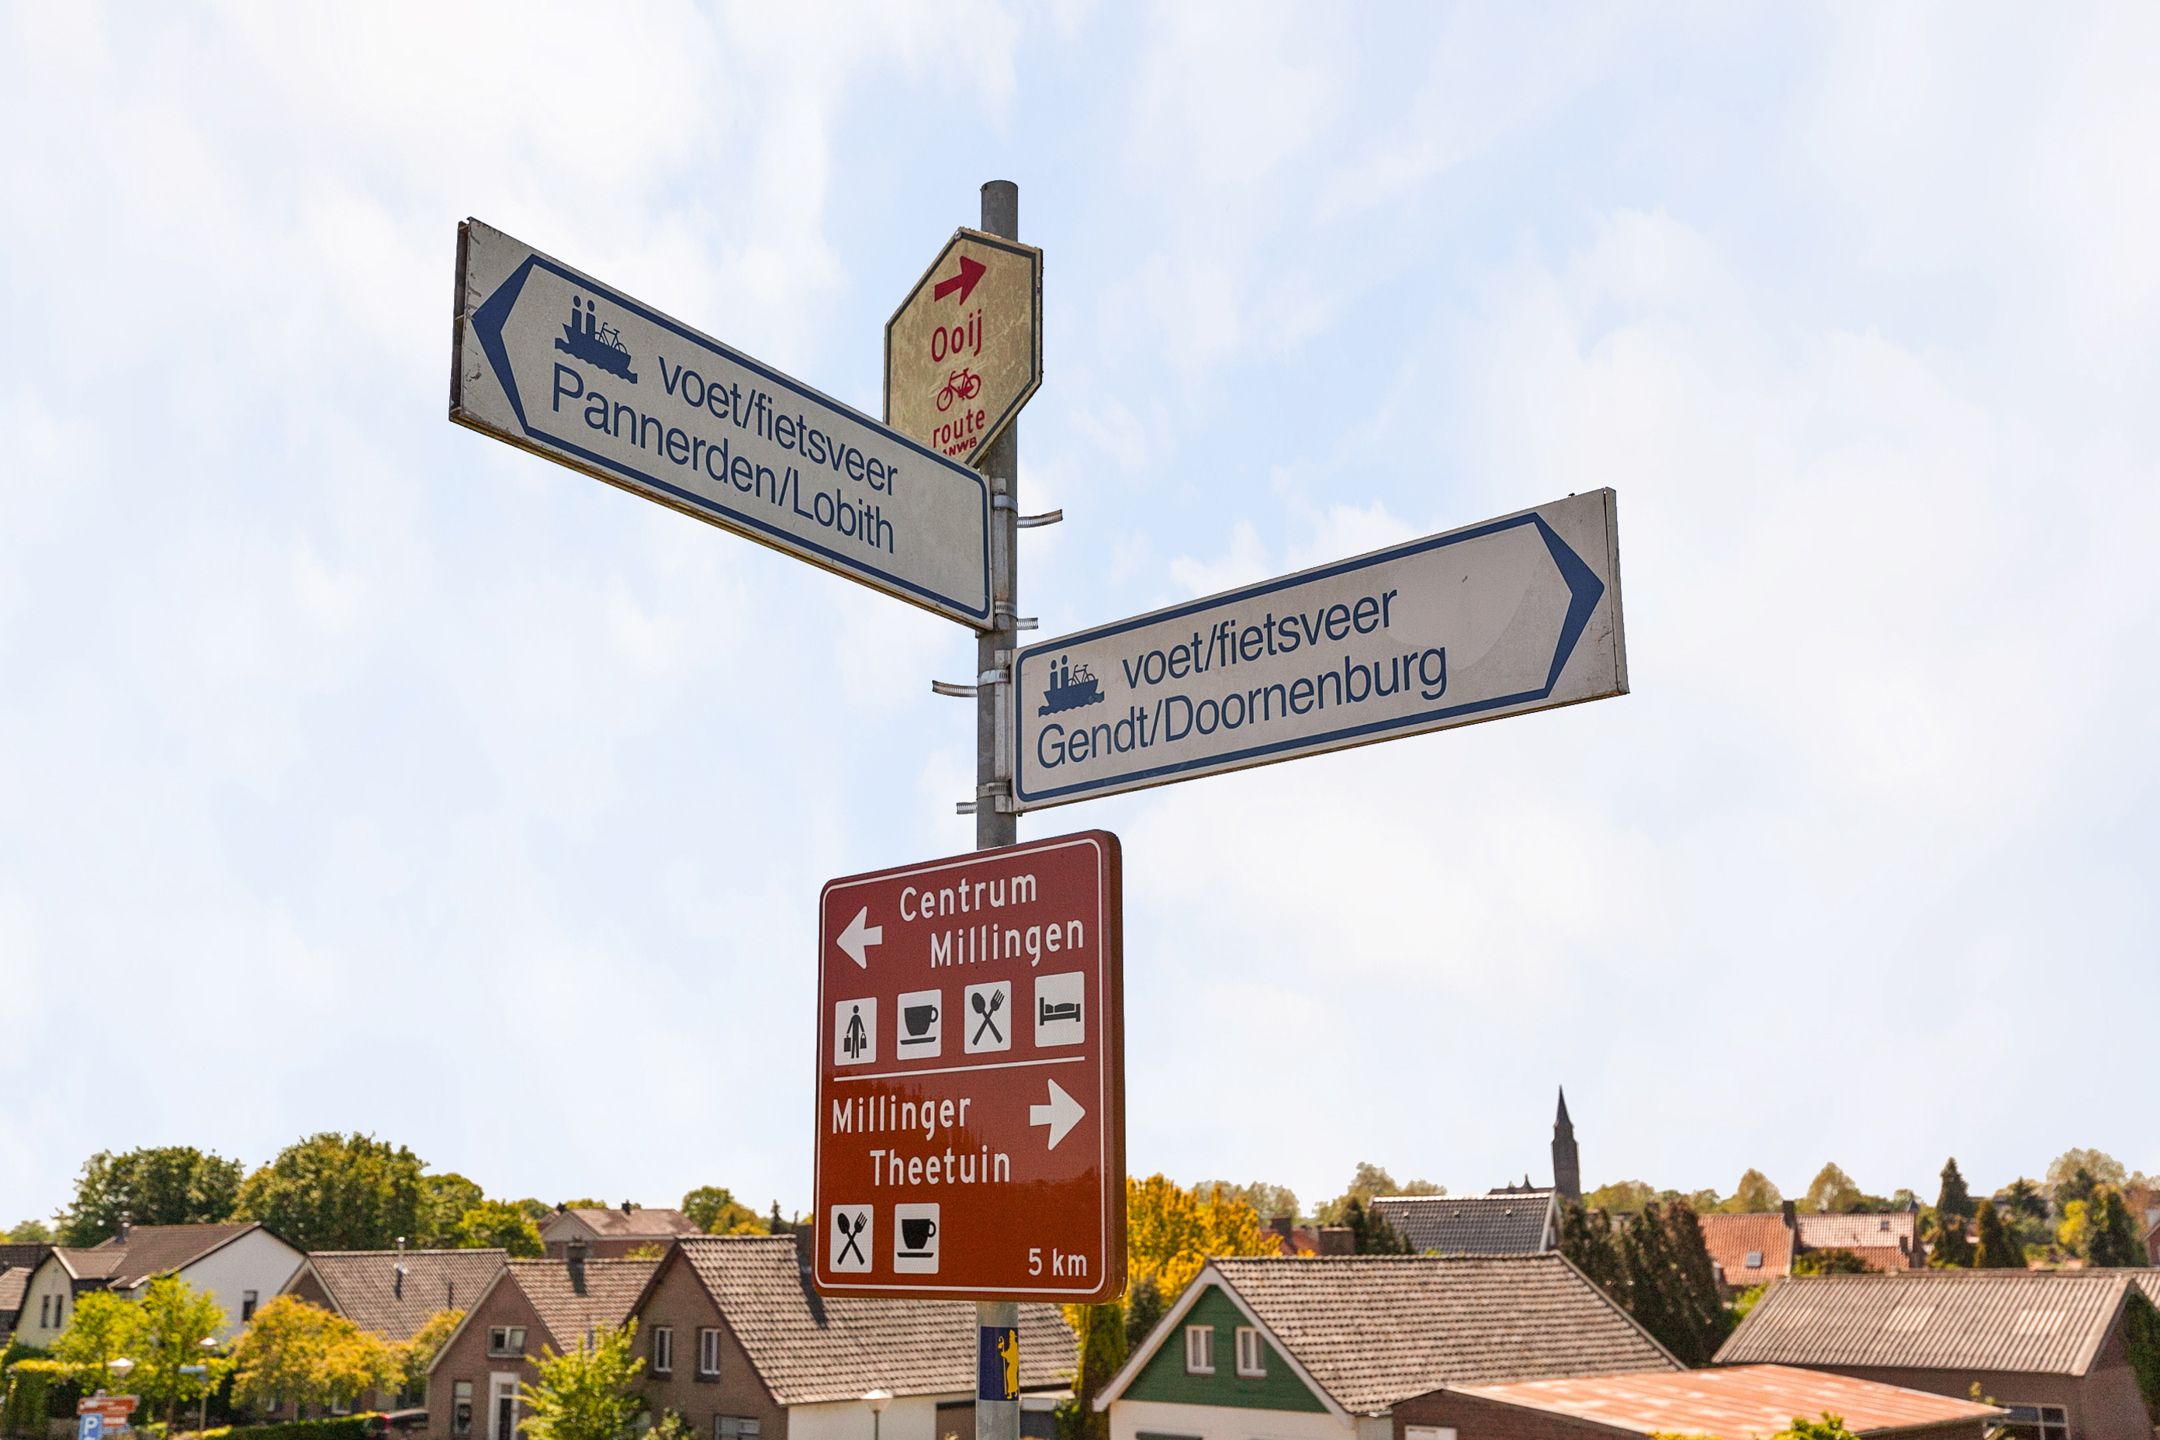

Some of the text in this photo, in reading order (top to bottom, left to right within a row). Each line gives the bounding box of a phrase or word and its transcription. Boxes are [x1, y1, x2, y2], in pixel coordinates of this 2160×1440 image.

[931, 308, 982, 362] Ooij
[658, 356, 898, 496] voet/fietsveer
[933, 408, 985, 448] route
[552, 362, 894, 554] Pannerden/Lobith
[1122, 589, 1397, 689] voet/fietsveer
[1037, 646, 1447, 769] Gendt/Doornenburg
[900, 873, 1037, 922] Centrum
[930, 919, 1084, 968] Millingen
[832, 1095, 971, 1141] Millinger
[870, 1145, 1011, 1186] Theetuin
[1028, 1248, 1087, 1276] 5 km
[85, 1417, 98, 1434] P
